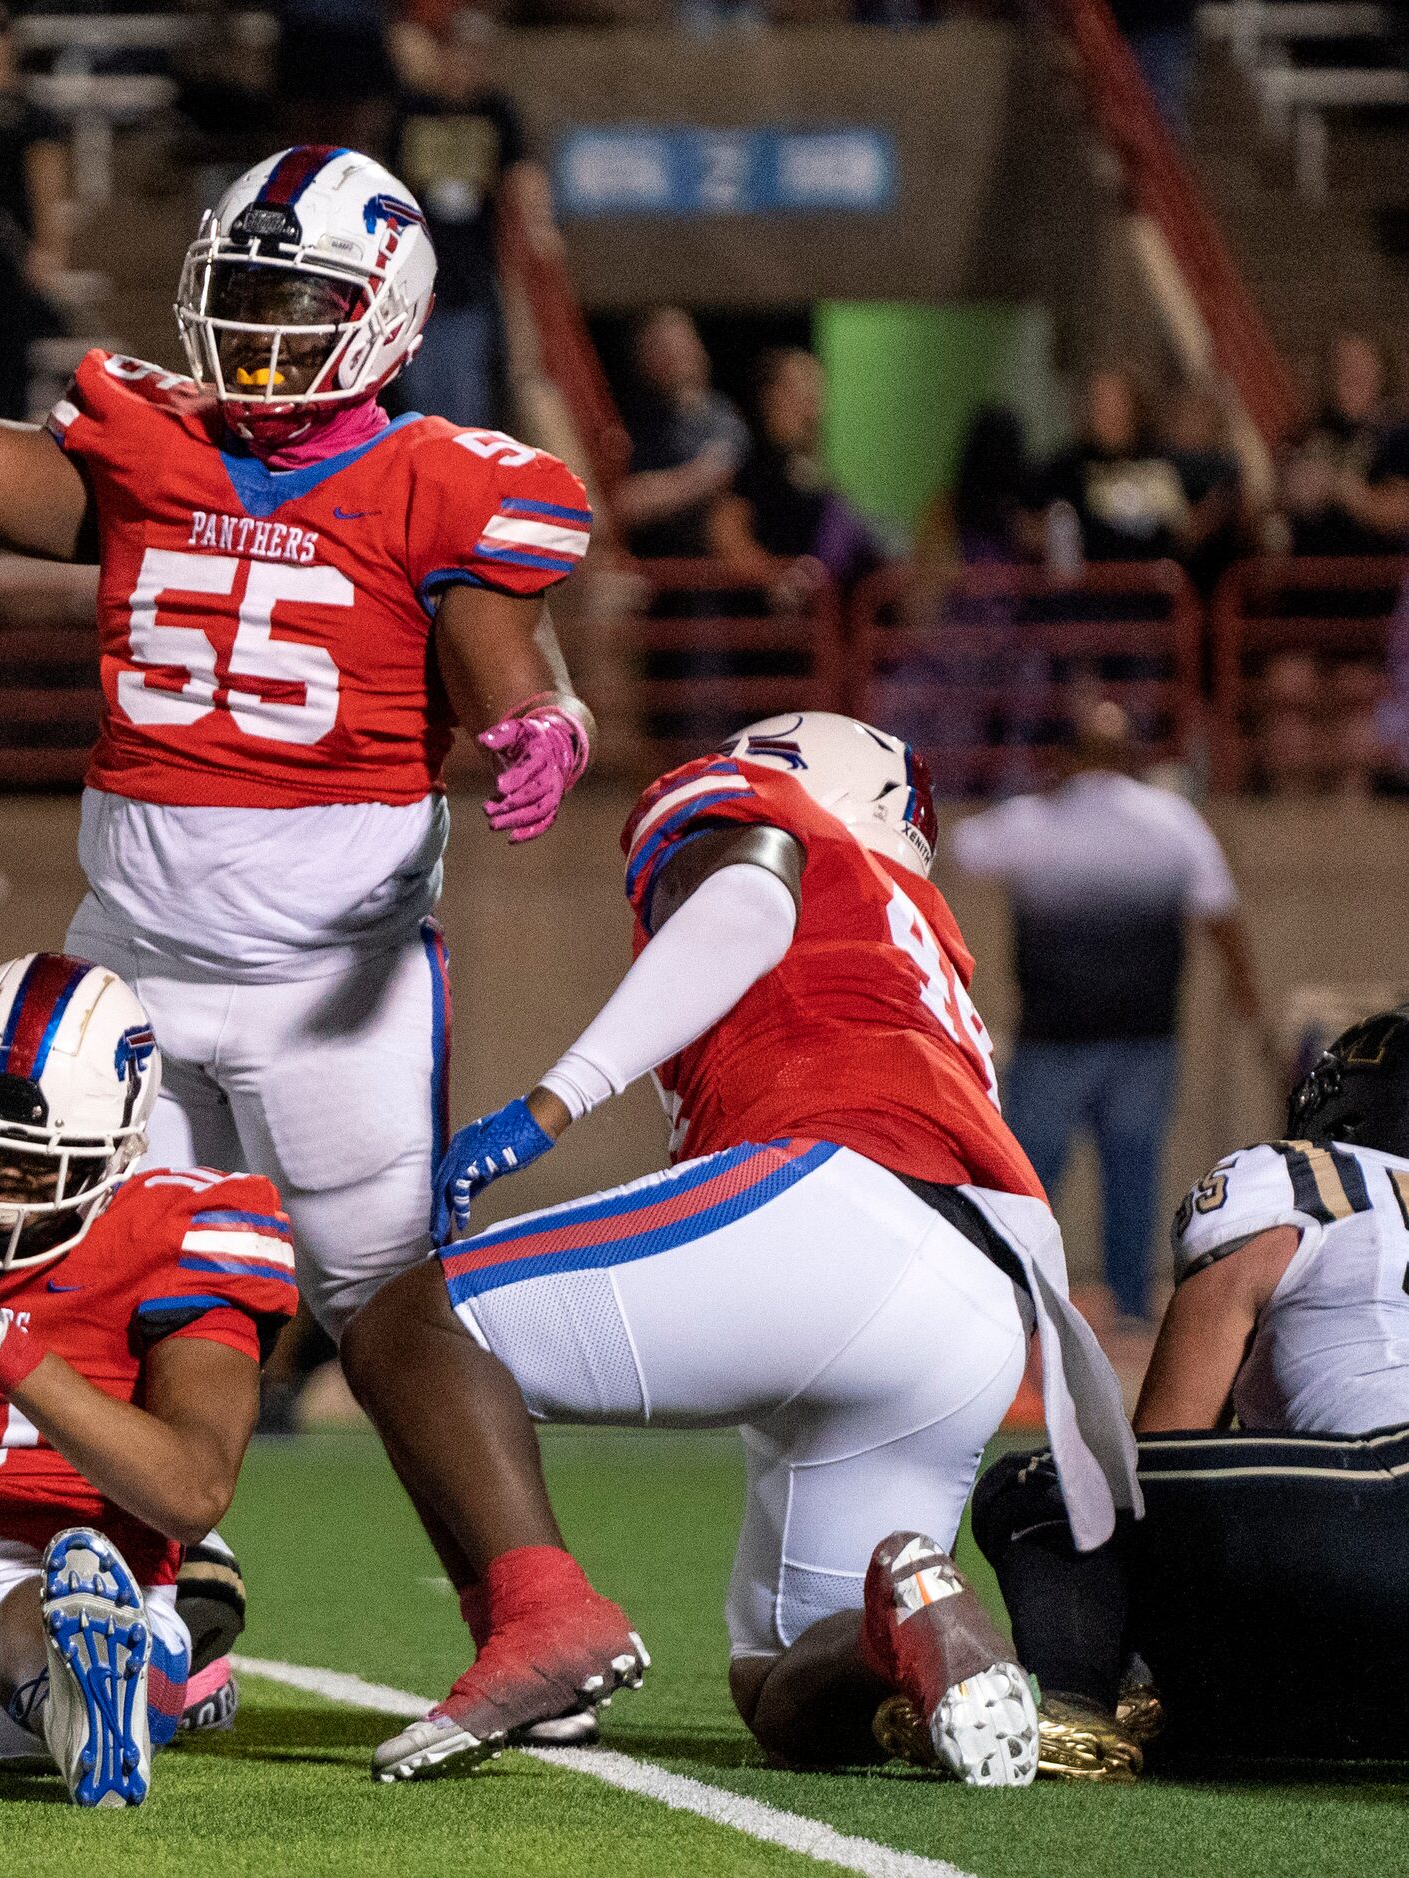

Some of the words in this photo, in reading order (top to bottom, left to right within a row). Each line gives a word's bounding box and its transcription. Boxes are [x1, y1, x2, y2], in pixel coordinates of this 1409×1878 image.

[188, 510, 319, 563] PANTHERS
[116, 547, 355, 746] 55
[901, 821, 931, 866] XENITH
